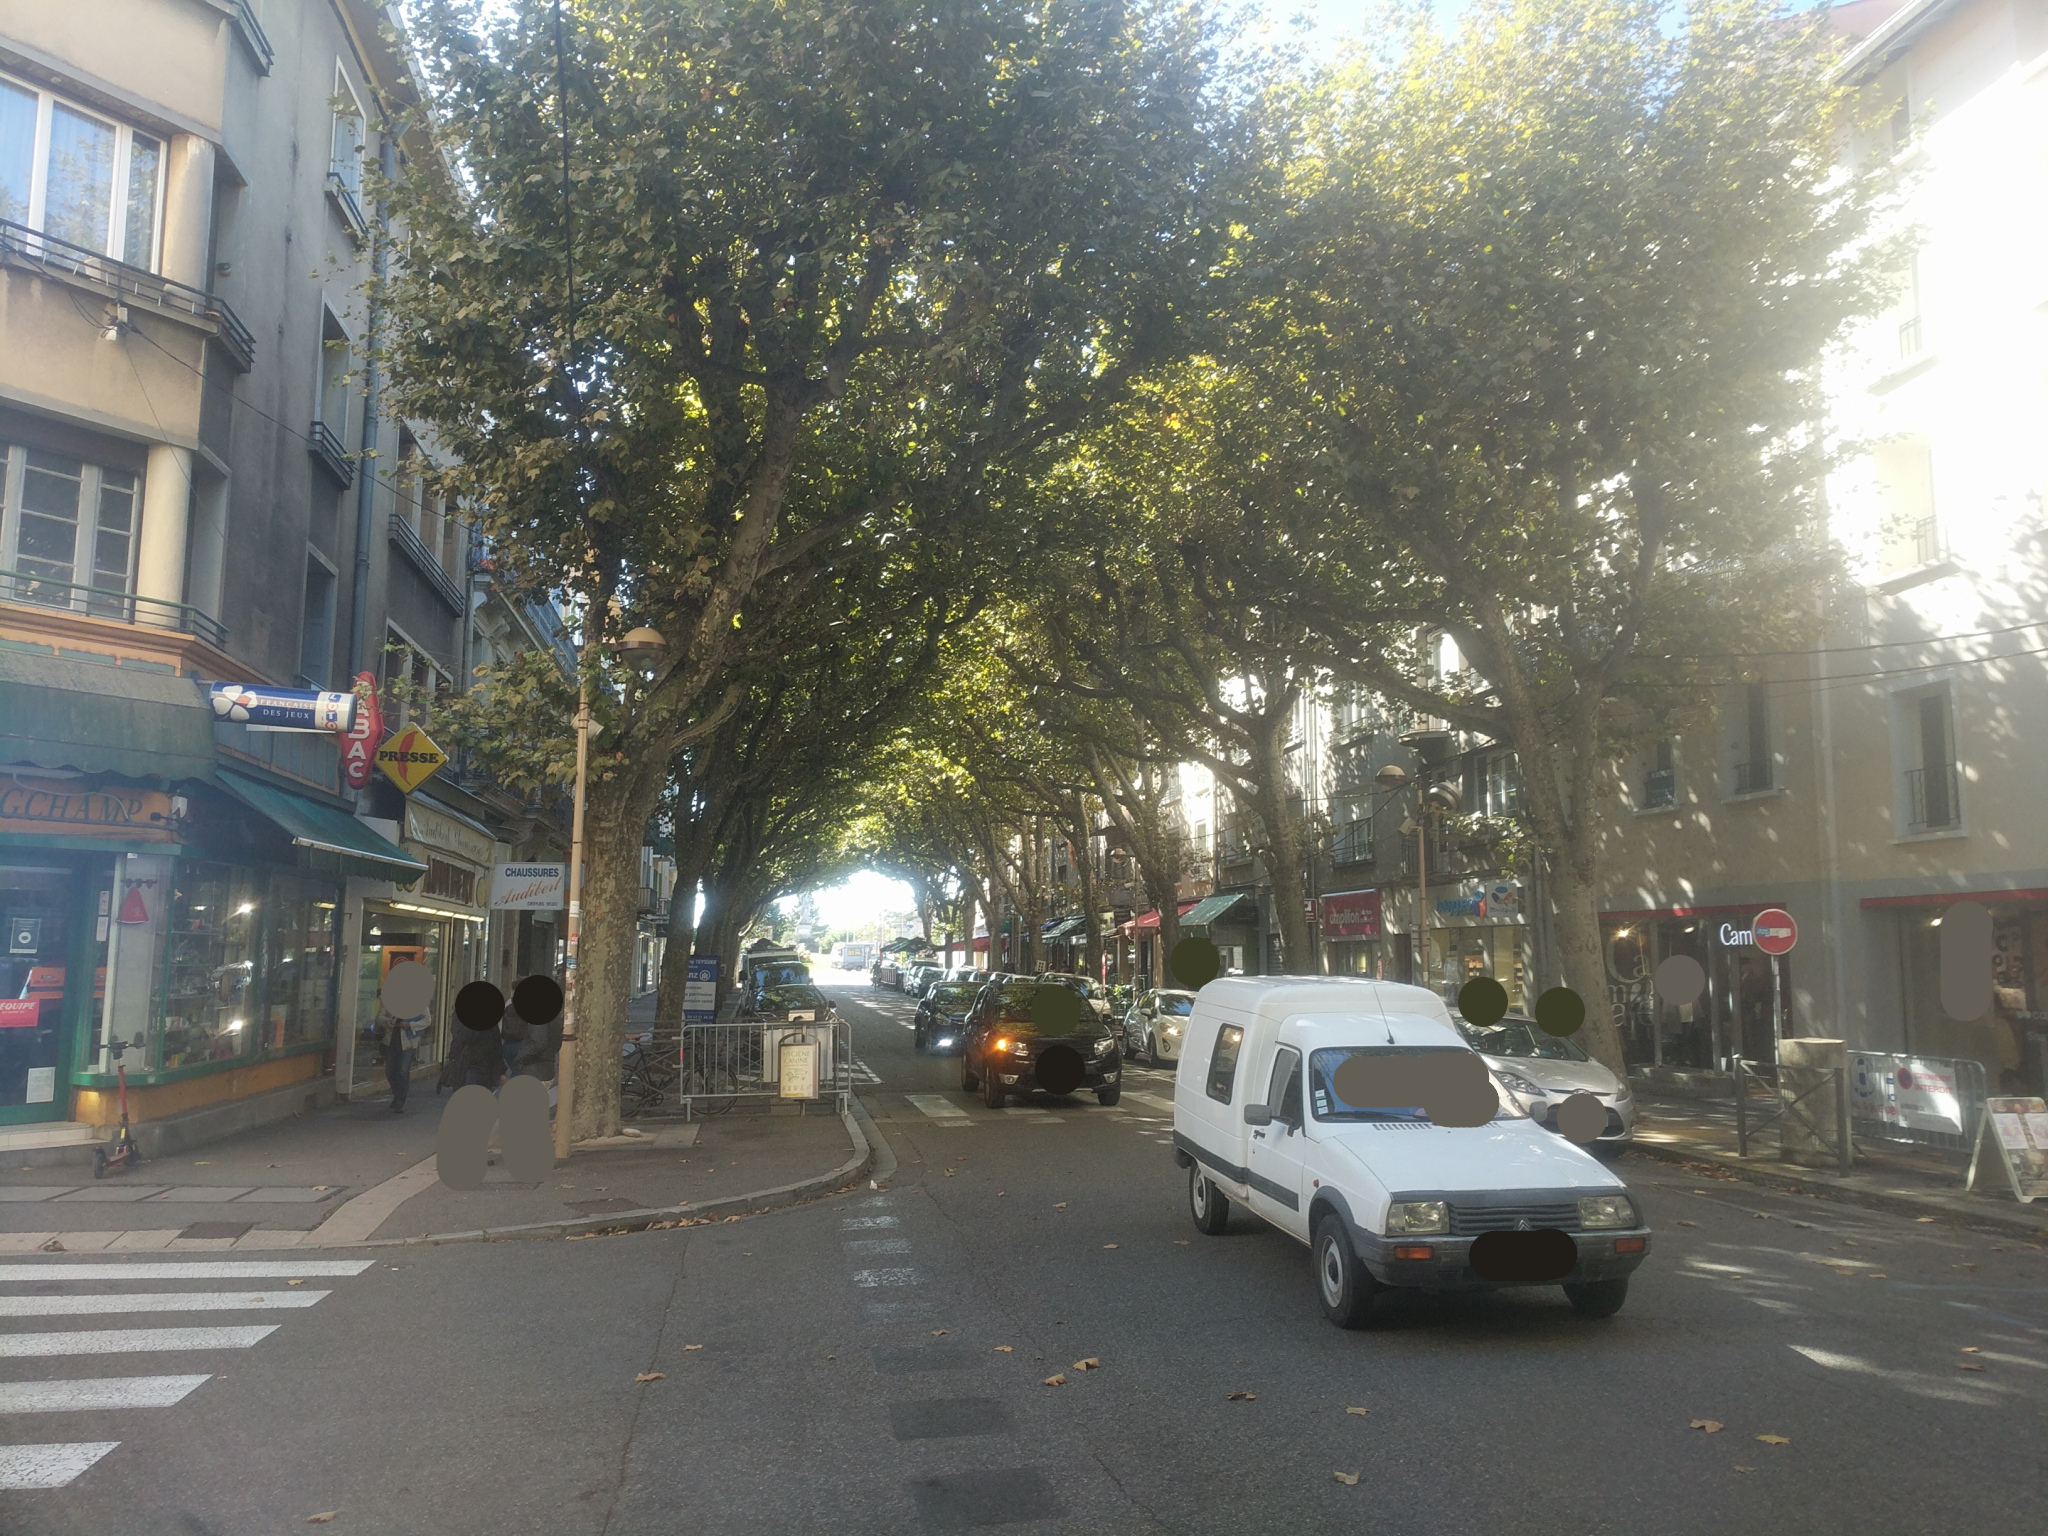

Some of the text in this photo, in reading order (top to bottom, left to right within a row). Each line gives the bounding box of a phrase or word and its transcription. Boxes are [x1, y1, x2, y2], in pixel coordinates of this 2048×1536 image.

[286, 711, 310, 719] JEUX
[325, 693, 341, 730] LOTO
[379, 751, 439, 763] PRESSE
[505, 867, 559, 878] CHAUSSURES
[494, 876, 563, 906] Audibert
[1915, 1084, 1953, 1095] INTERDIT
